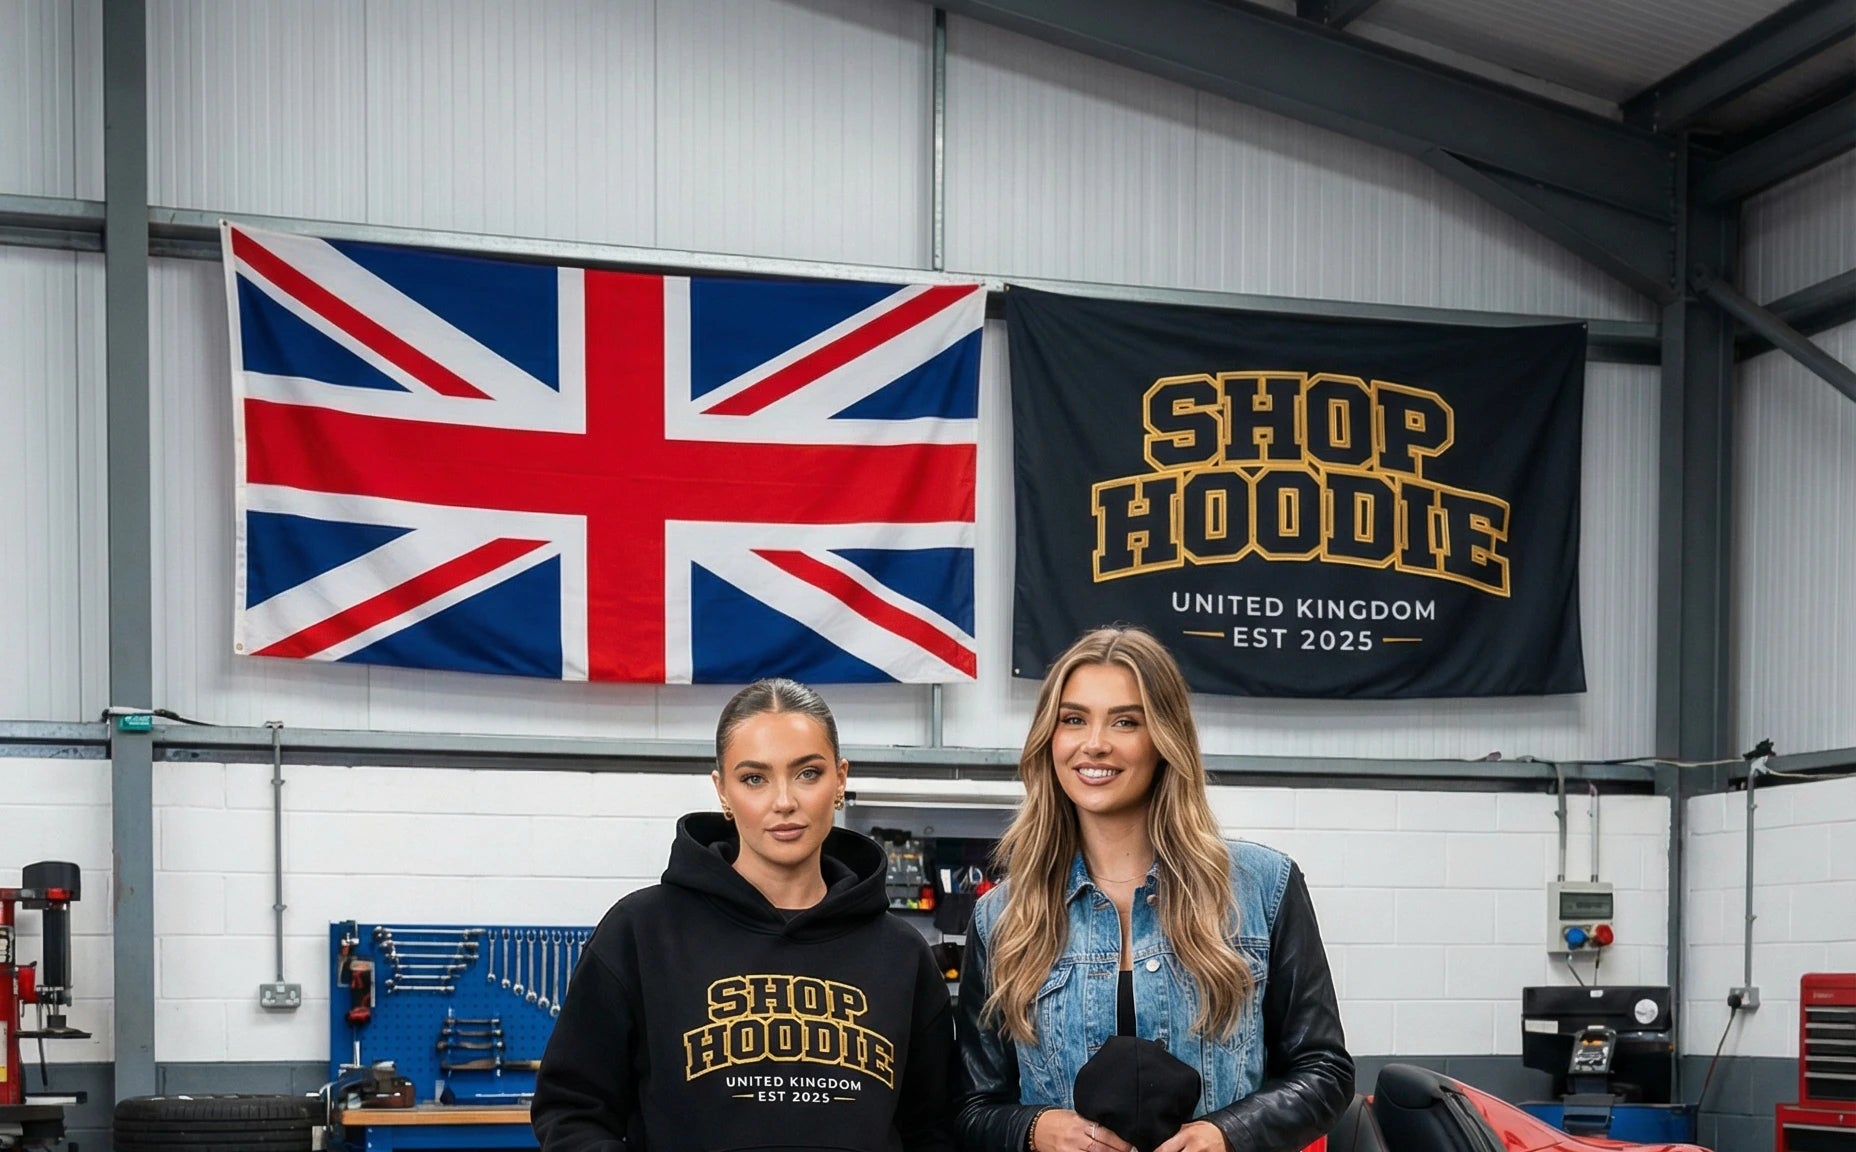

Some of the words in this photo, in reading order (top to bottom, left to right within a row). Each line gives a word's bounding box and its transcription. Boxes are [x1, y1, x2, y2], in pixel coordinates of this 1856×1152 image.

[1143, 370, 1455, 479] SHOP
[1091, 464, 1511, 598] HOODIE
[1172, 591, 1284, 618] UNITED
[1297, 598, 1436, 621] KINGDOM
[1233, 626, 1288, 650] EST
[1300, 629, 1374, 652] 2025
[707, 974, 868, 1024] SHOP
[683, 1016, 894, 1090] HOODIE
[726, 1075, 784, 1088] UNITED
[789, 1076, 862, 1091] KINGDOM
[758, 1091, 786, 1102] EST
[792, 1091, 830, 1104] 2025
